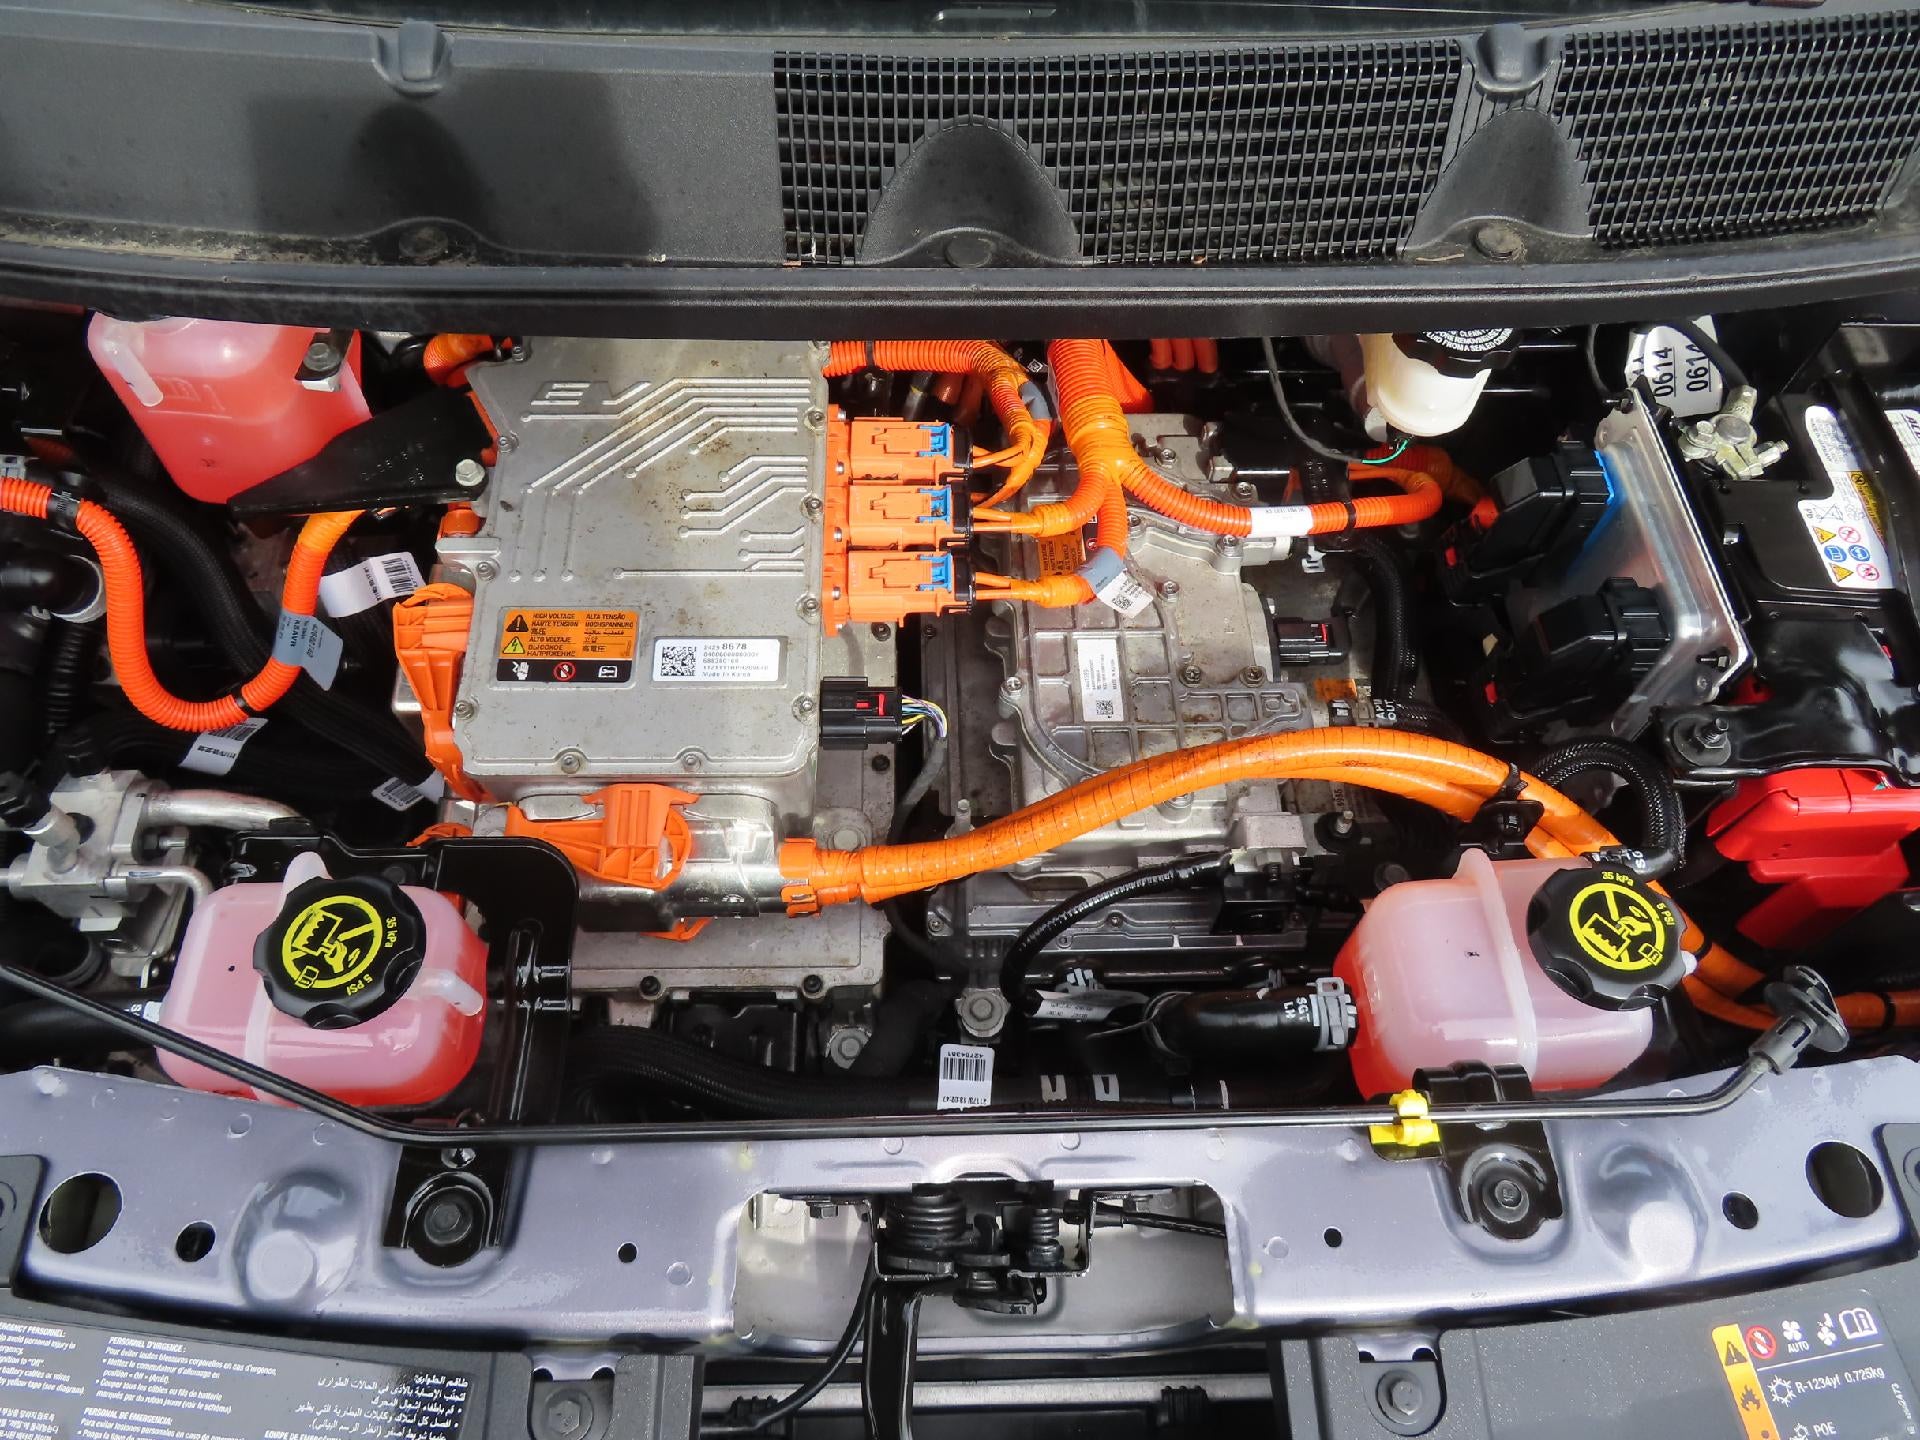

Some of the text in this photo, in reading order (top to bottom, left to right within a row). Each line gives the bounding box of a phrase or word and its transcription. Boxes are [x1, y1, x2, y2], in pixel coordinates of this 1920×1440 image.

[1442, 340, 1464, 352] FROM
[1464, 344, 1470, 352] A
[1470, 342, 1496, 352] SEALED
[1652, 346, 1673, 397] 0614
[1602, 872, 1634, 886] 35 kPa
[1656, 902, 1676, 926] 5 PSI
[384, 916, 397, 948] 35 kPa
[346, 974, 373, 996] 5 PSI
[1296, 996, 1310, 1022] SGT
[0, 1321, 66, 1338] ERGENCY PERSONNEL:
[0, 1344, 24, 1356] ergency,
[24, 1337, 51, 1347] personal
[51, 1340, 69, 1350] injury
[108, 1336, 146, 1348] PERSONNEL
[146, 1340, 182, 1352] D'URGENCE
[1788, 1341, 1810, 1354] AUTO
[20, 1357, 27, 1365] to
[104, 1346, 119, 1356] Pour
[120, 1348, 138, 1359] éviter
[139, 1350, 158, 1361] toutes
[158, 1352, 188, 1364] blessures
[188, 1357, 223, 1370] corporelles
[232, 1364, 244, 1372] cas
[2, 1366, 24, 1377] battery
[24, 1370, 45, 1379] cables
[53, 1372, 71, 1382] wires
[103, 1369, 128, 1380] position
[134, 1370, 144, 1380] Off
[106, 1358, 128, 1368] Mettez
[129, 1360, 136, 1369] le
[136, 1362, 176, 1375] commutateur
[177, 1366, 211, 1380] d'allumage
[6, 1378, 29, 1387] yellow
[28, 1380, 42, 1390] tape
[42, 1382, 56, 1391] (see
[350, 1380, 377, 1390] الحالات
[446, 1378, 469, 1388] طاقم
[1795, 1366, 1885, 1394] R-1234yf 0.725kg
[100, 1378, 122, 1390] Couper
[122, 1381, 137, 1390] tous
[137, 1383, 147, 1391] les
[148, 1383, 168, 1394] câbles
[198, 1391, 222, 1401] batterie
[378, 1382, 389, 1394] في
[96, 1390, 123, 1401] marqués
[125, 1394, 135, 1403] par
[144, 1395, 164, 1404] ruban
[182, 1398, 196, 1409] (voir
[371, 1396, 398, 1408] المحرك
[83, 1406, 174, 1426] PERSONAL DE EMERGENCIA:
[316, 1403, 331, 1416] التي
[445, 1404, 454, 1416] قم
[80, 1418, 95, 1427] Para
[96, 1420, 114, 1430] evitar
[114, 1422, 140, 1432] lesiones
[140, 1425, 175, 1437] personales
[339, 1423, 360, 1433] الرسم
[418, 1416, 429, 1427] كل
[82, 1429, 102, 1440] Ponga
[1813, 1422, 1837, 1438] POE
